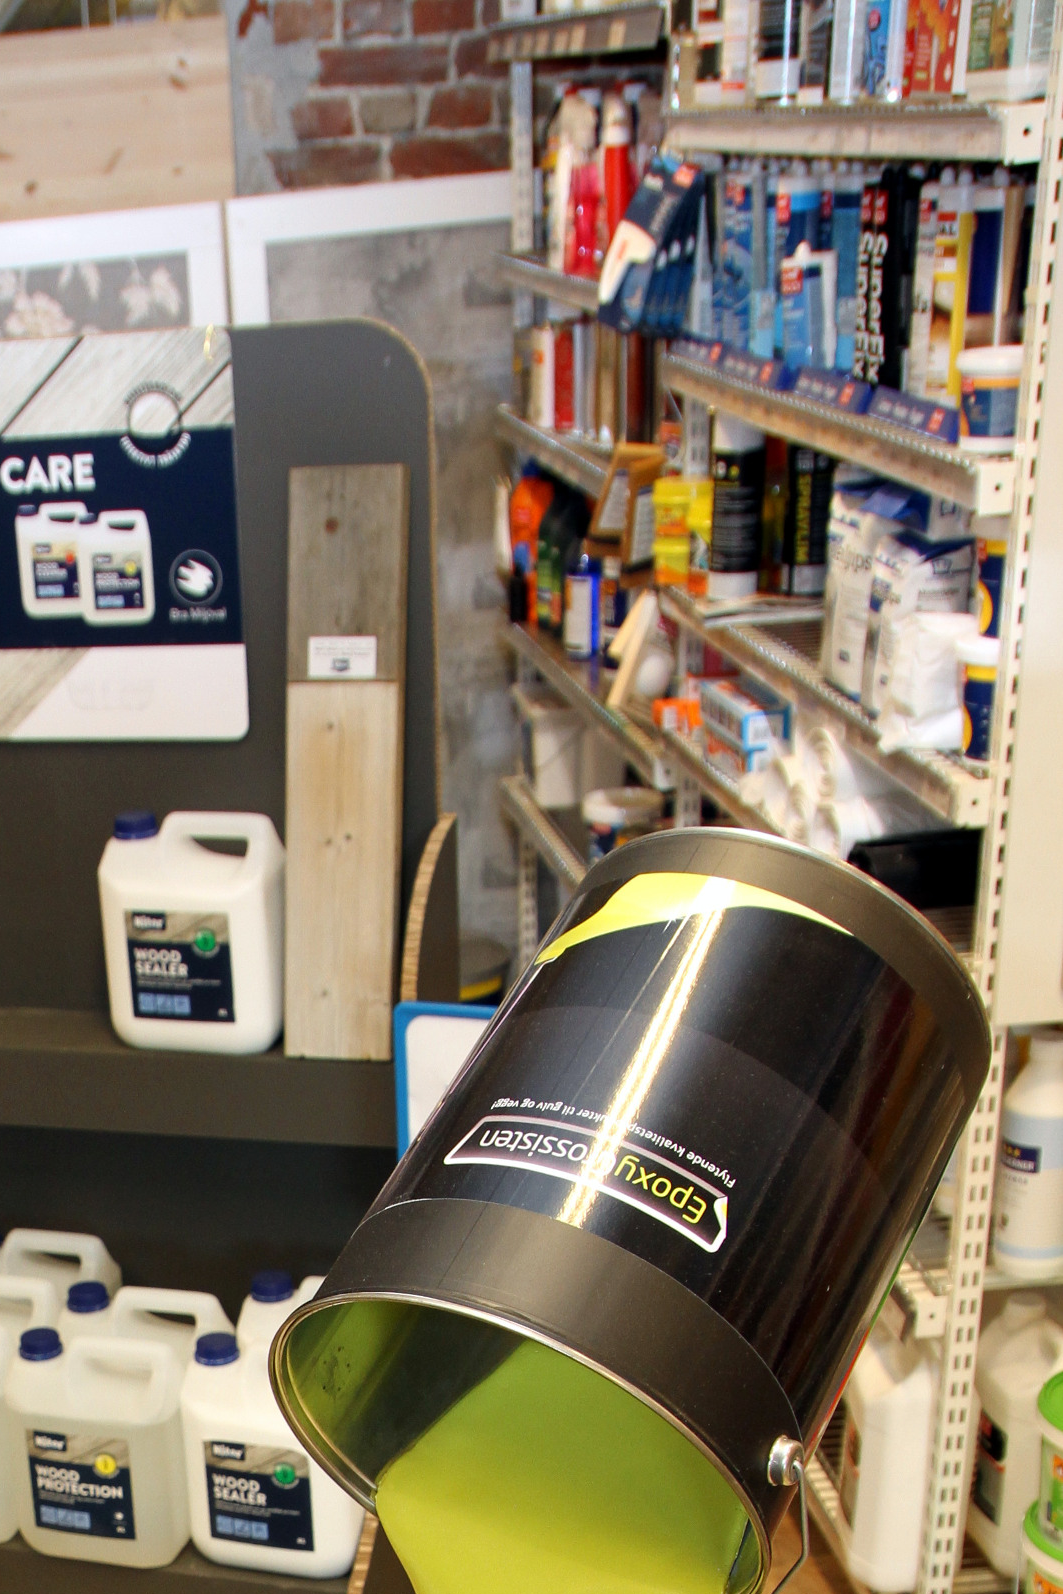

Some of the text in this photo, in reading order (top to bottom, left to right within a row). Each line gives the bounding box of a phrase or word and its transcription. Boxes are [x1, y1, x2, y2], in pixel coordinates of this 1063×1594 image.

[0, 452, 96, 495] CARE
[134, 947, 182, 962] WOOD
[135, 960, 189, 977] SEALER
[491, 1097, 736, 1189] Flytende kvalitetspukter til gulv og vegg!
[35, 1463, 81, 1482] WOOD
[212, 1472, 261, 1492] WOOD
[36, 1476, 124, 1499] PROTECTION
[213, 1485, 268, 1507] SEALER
